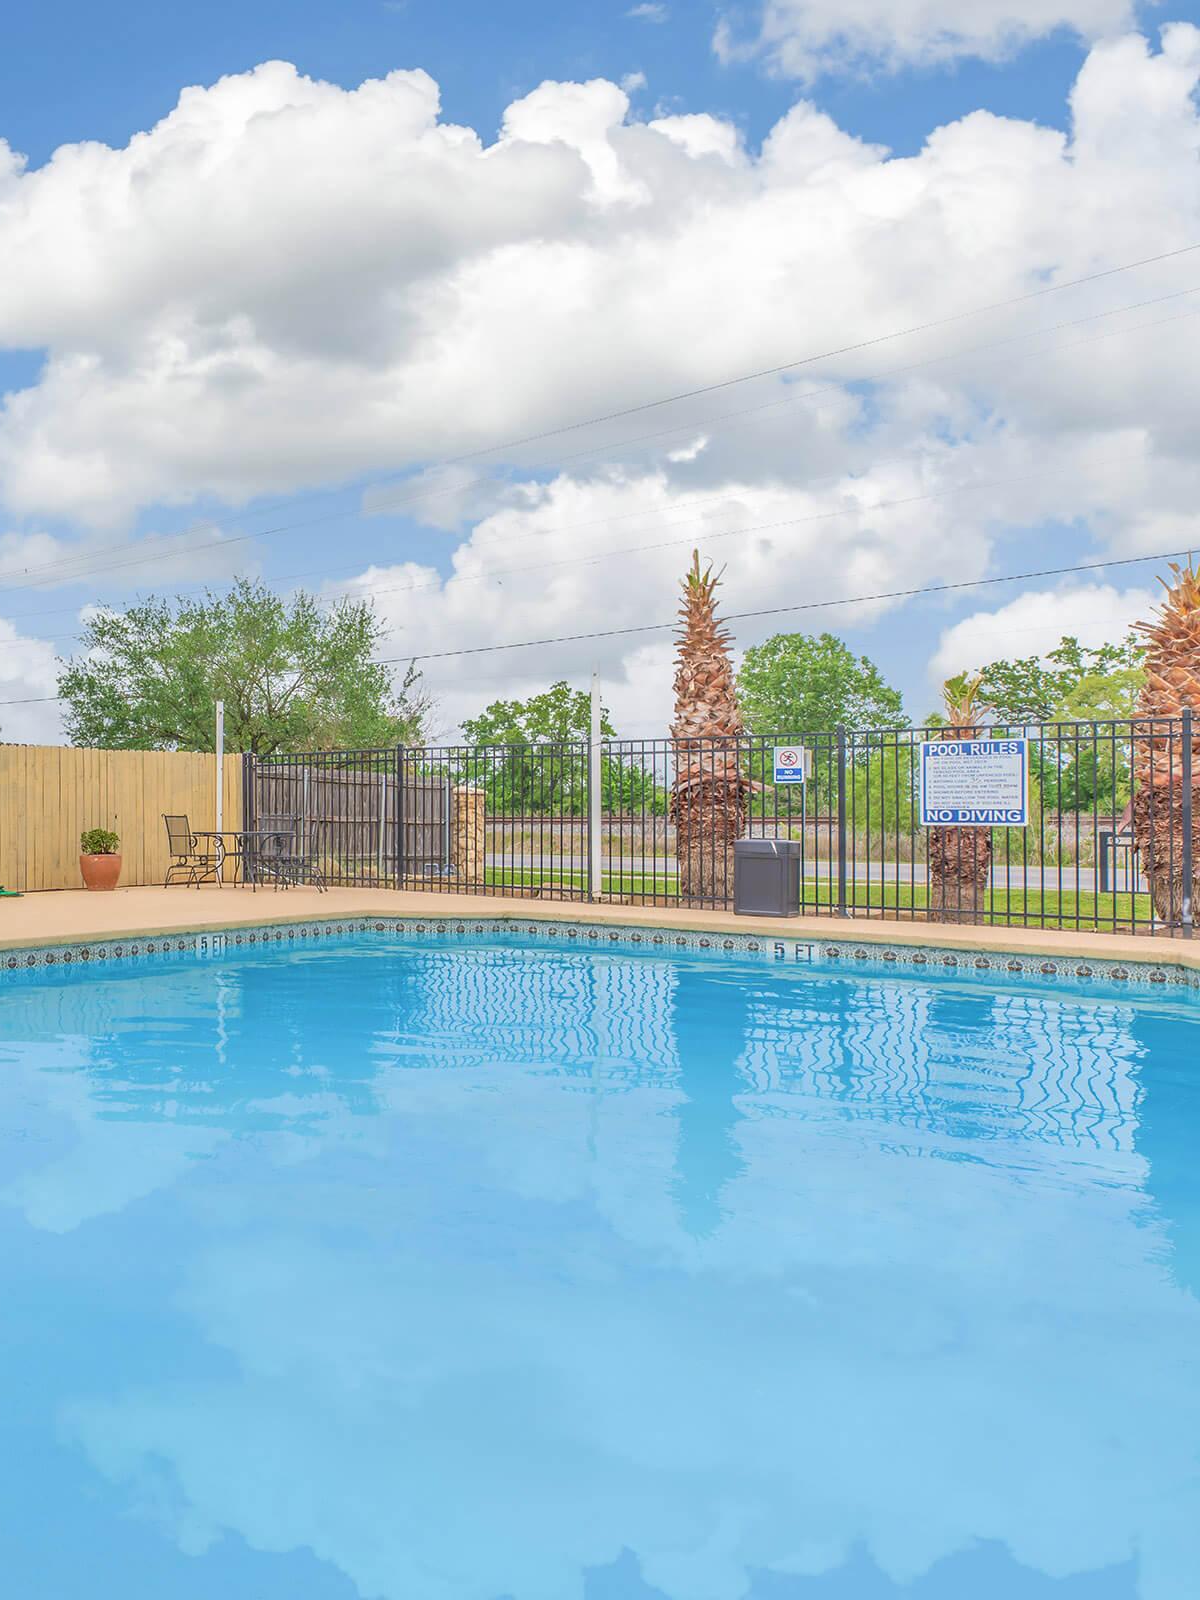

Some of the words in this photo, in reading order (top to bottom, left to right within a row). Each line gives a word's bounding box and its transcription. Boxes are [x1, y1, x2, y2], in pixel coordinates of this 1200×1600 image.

[929, 744, 967, 755] POOL
[971, 742, 1018, 755] RULES
[927, 810, 952, 821] NO
[959, 810, 1021, 822] DIVING
[201, 936, 208, 949] 5
[213, 935, 223, 948] FT
[774, 942, 784, 954] 5
[796, 943, 814, 956] FT
